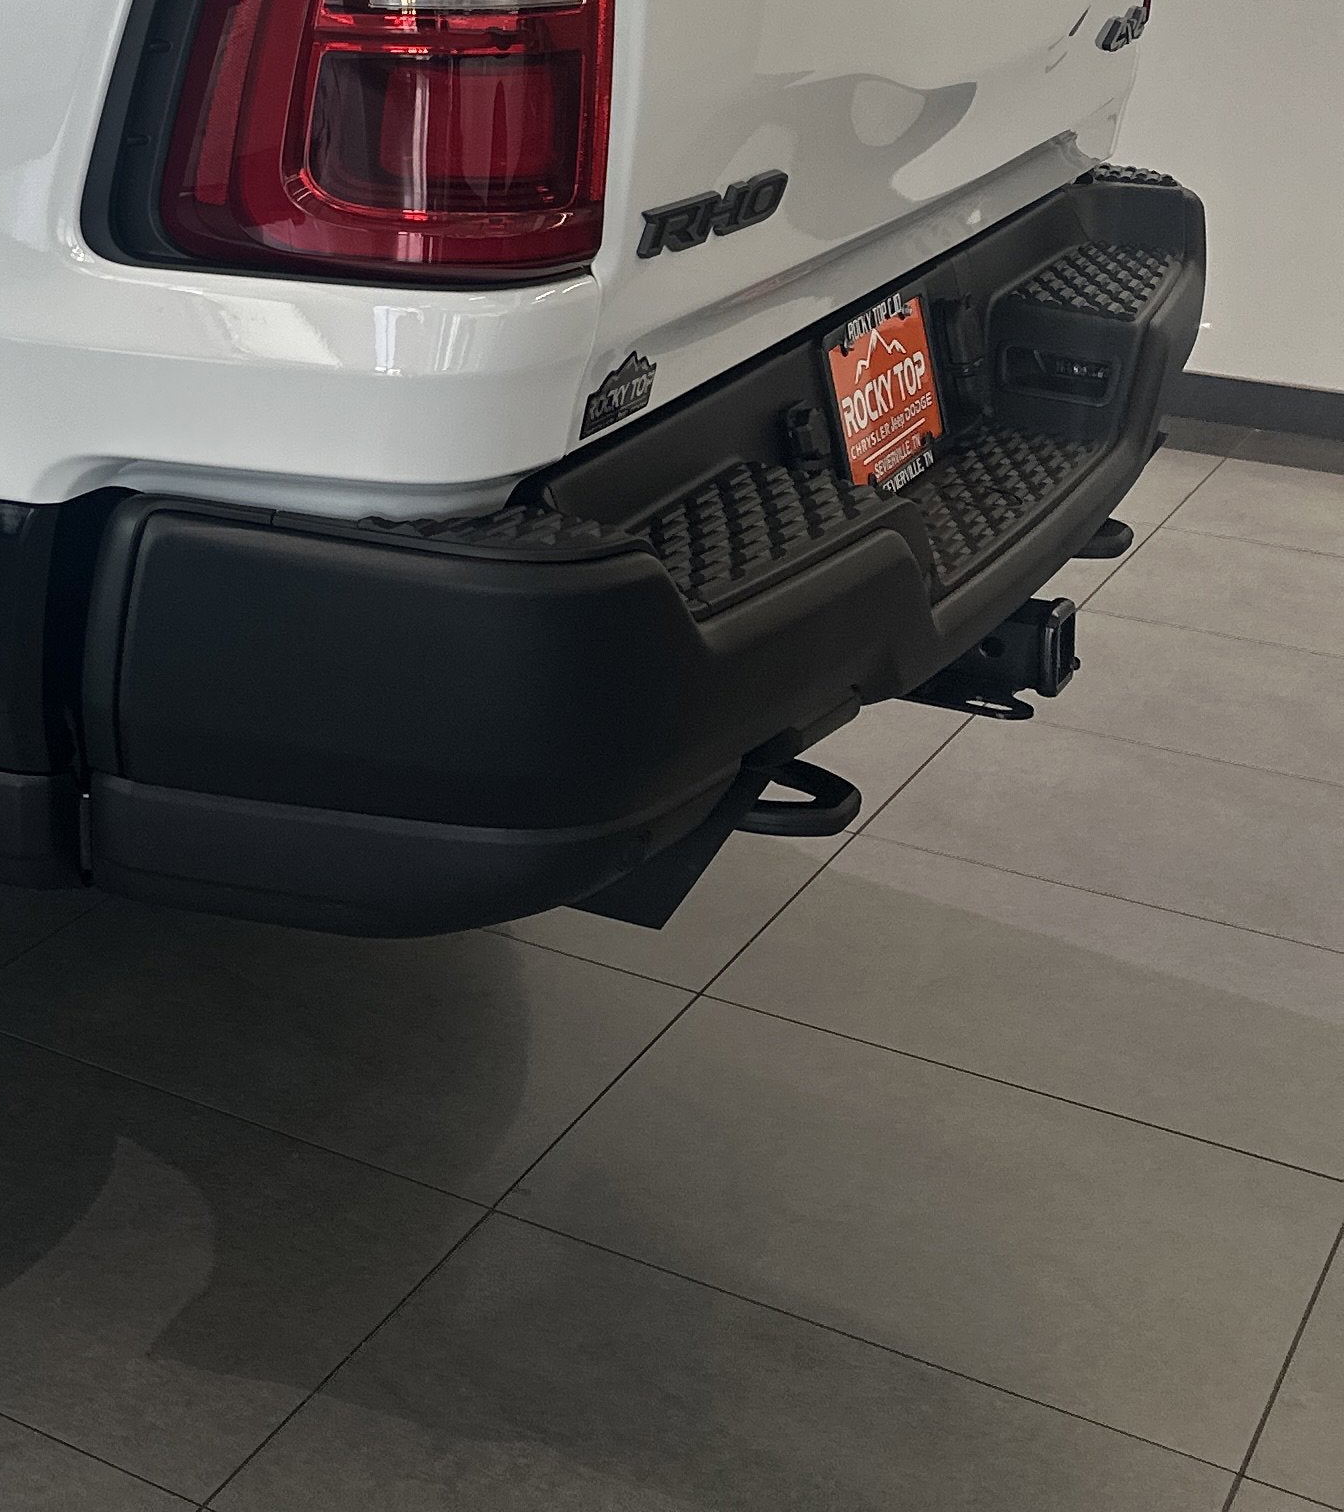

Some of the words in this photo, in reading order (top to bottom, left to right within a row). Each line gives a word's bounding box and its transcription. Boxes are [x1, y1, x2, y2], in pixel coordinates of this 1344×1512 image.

[637, 169, 789, 259] RHO
[847, 310, 872, 341] ROCKY
[871, 301, 888, 330] TOP
[841, 370, 894, 438] ROCKY
[893, 351, 926, 401] TOP
[850, 423, 891, 460] CHRYSLER
[904, 391, 933, 421] DODGE
[923, 449, 934, 468] TN
